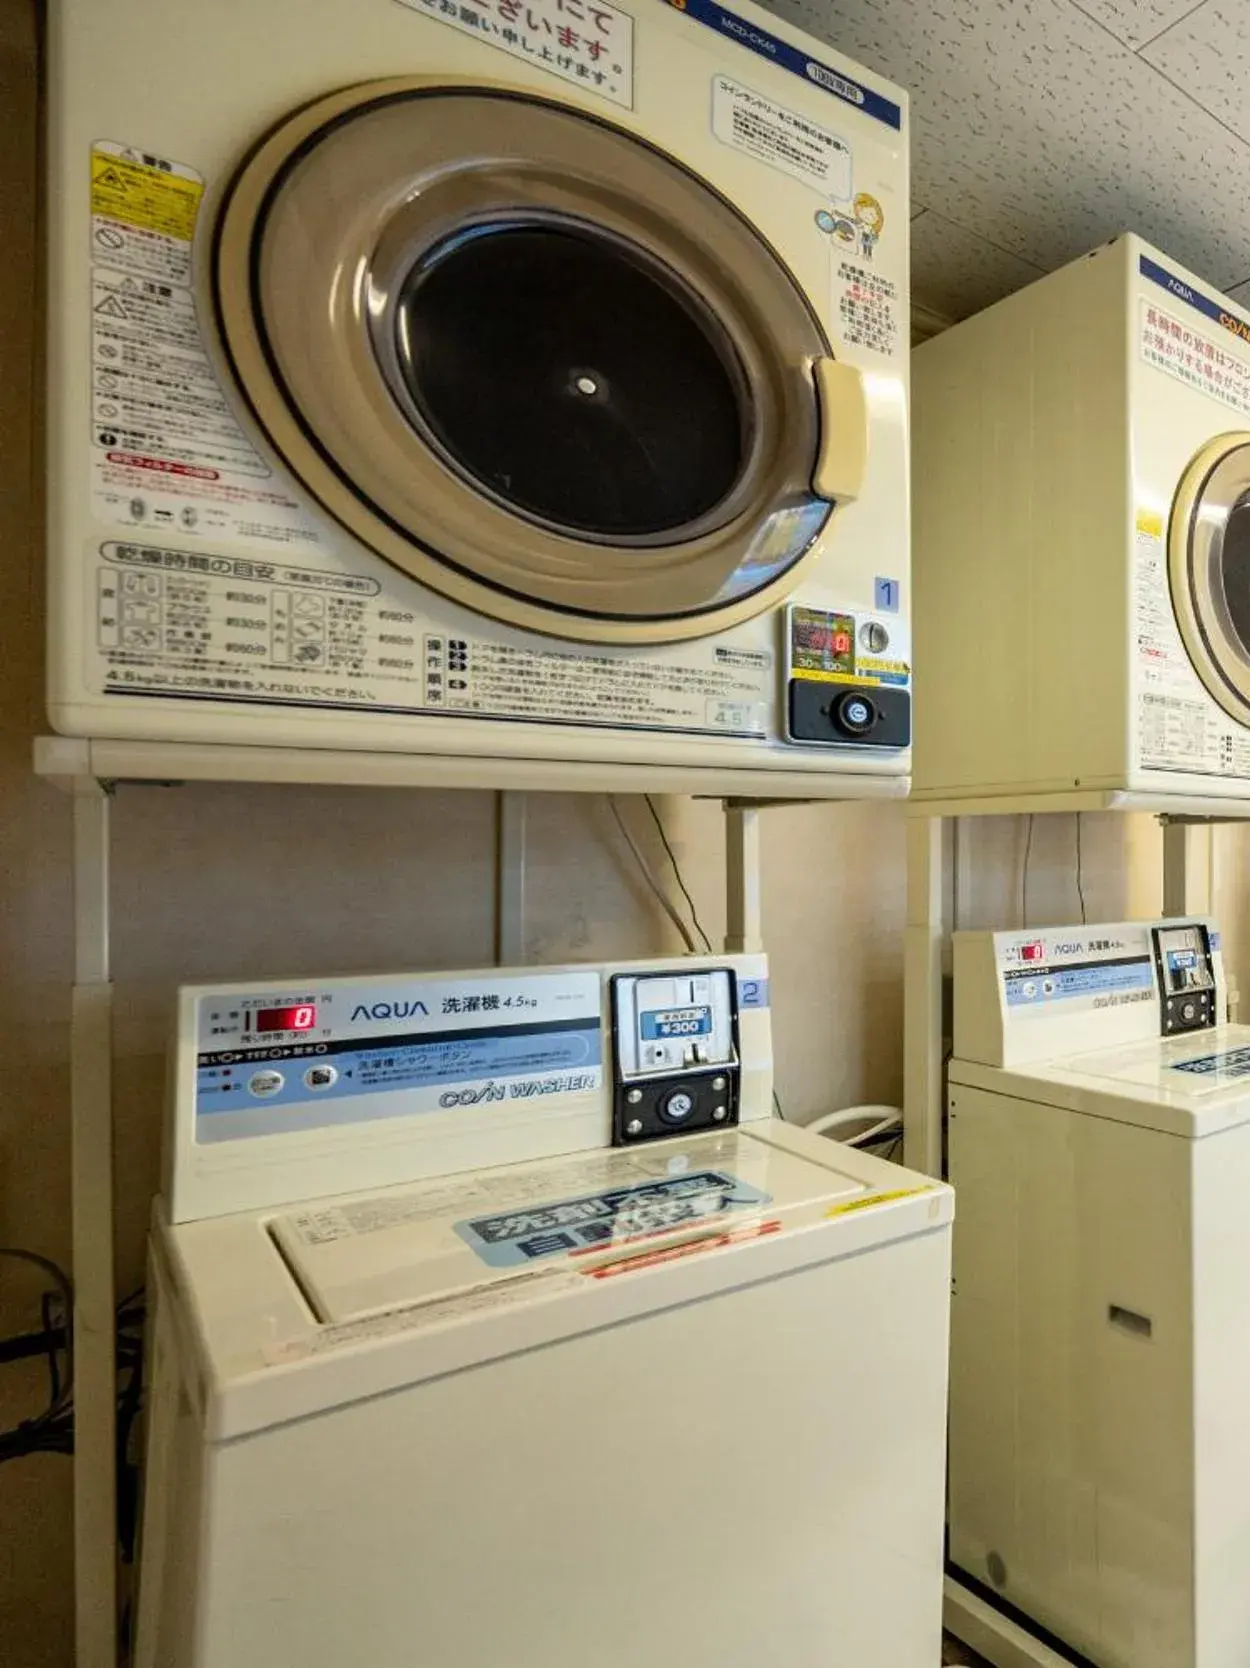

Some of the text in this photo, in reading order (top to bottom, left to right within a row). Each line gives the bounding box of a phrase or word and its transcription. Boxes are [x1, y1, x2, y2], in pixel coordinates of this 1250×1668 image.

[880, 582, 892, 606] 1
[742, 982, 759, 1003] 2
[294, 1007, 313, 1028] 0
[351, 1001, 429, 1021] AQUA
[442, 994, 499, 1014] 洗濯機
[439, 1073, 595, 1109] COIN WASHER
